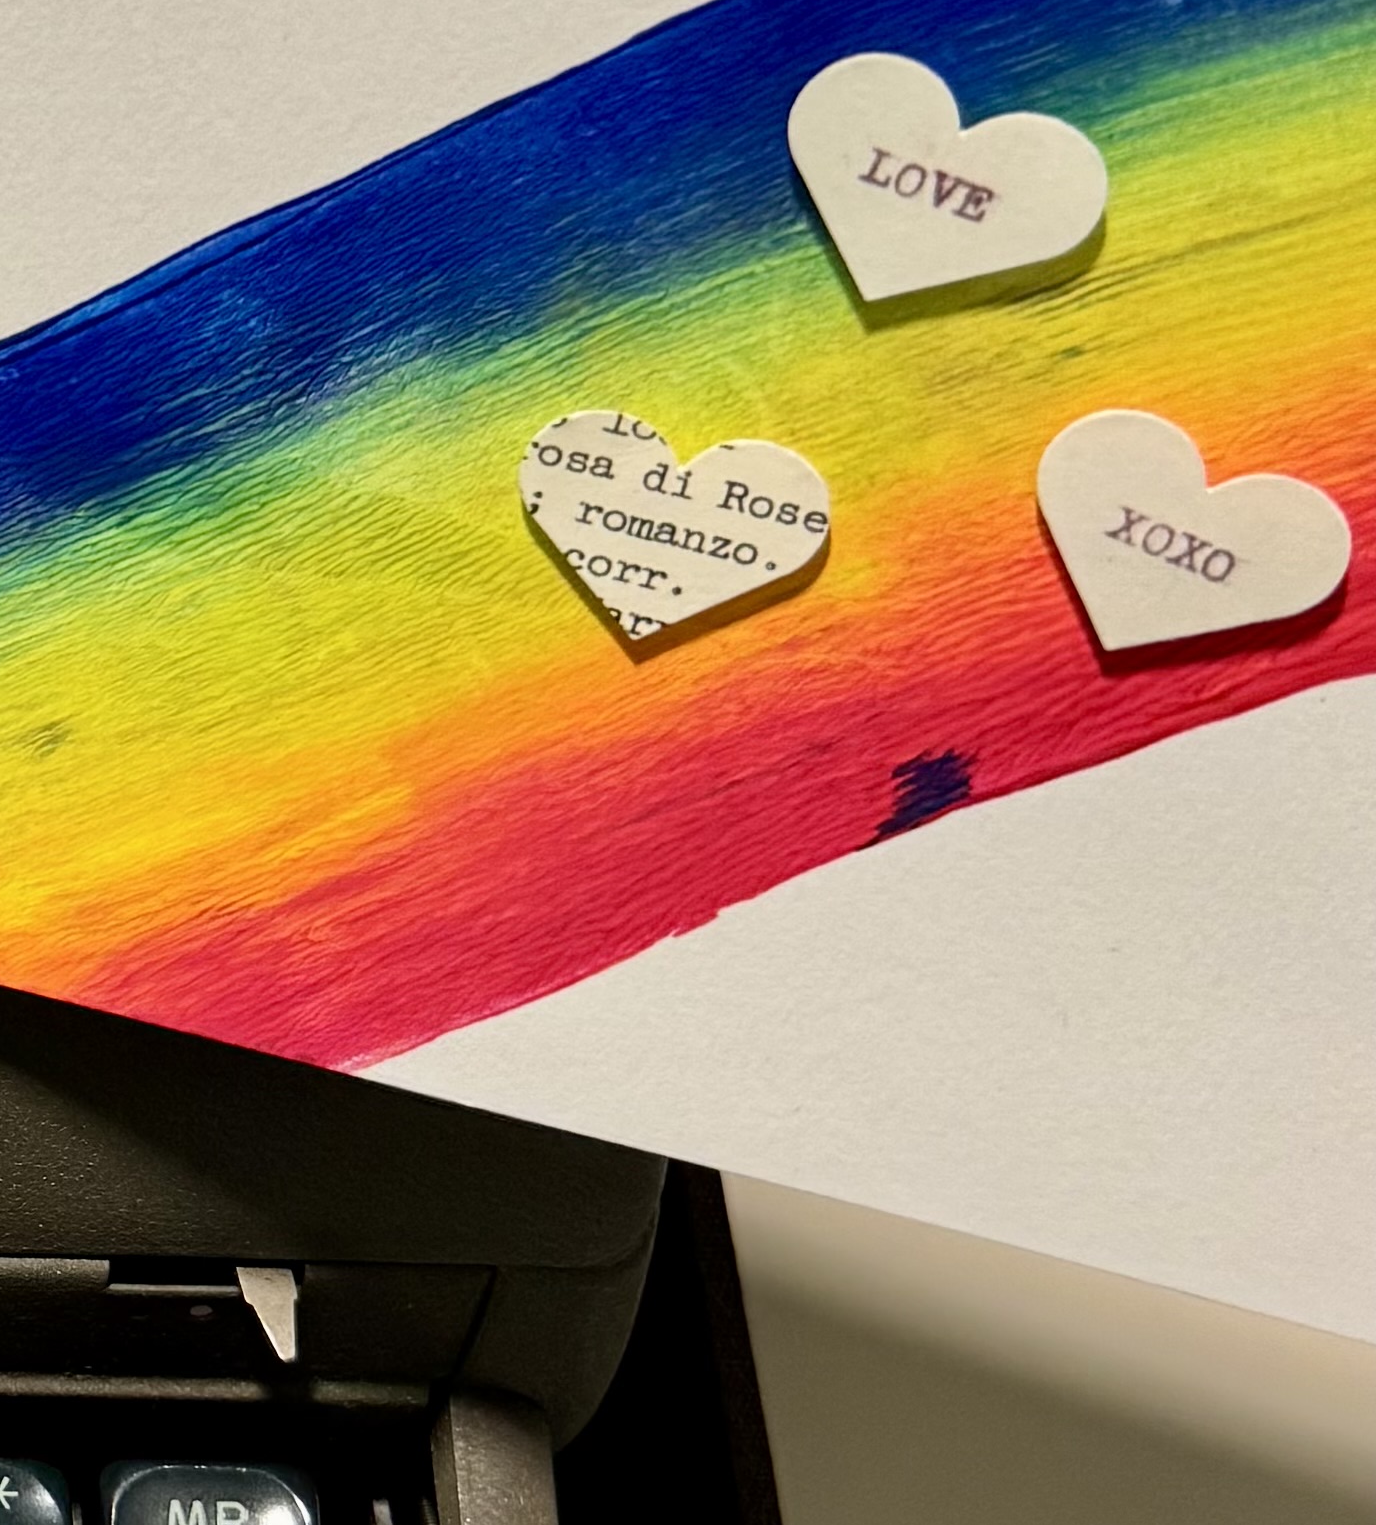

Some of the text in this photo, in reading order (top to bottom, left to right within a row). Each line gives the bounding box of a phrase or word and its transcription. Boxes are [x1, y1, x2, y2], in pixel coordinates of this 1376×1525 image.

[859, 149, 994, 223] LOVE
[523, 441, 829, 534] osa di Rose
[564, 547, 683, 596] corr.
[574, 501, 778, 572] romanzo.
[1105, 507, 1236, 584] XOXO
